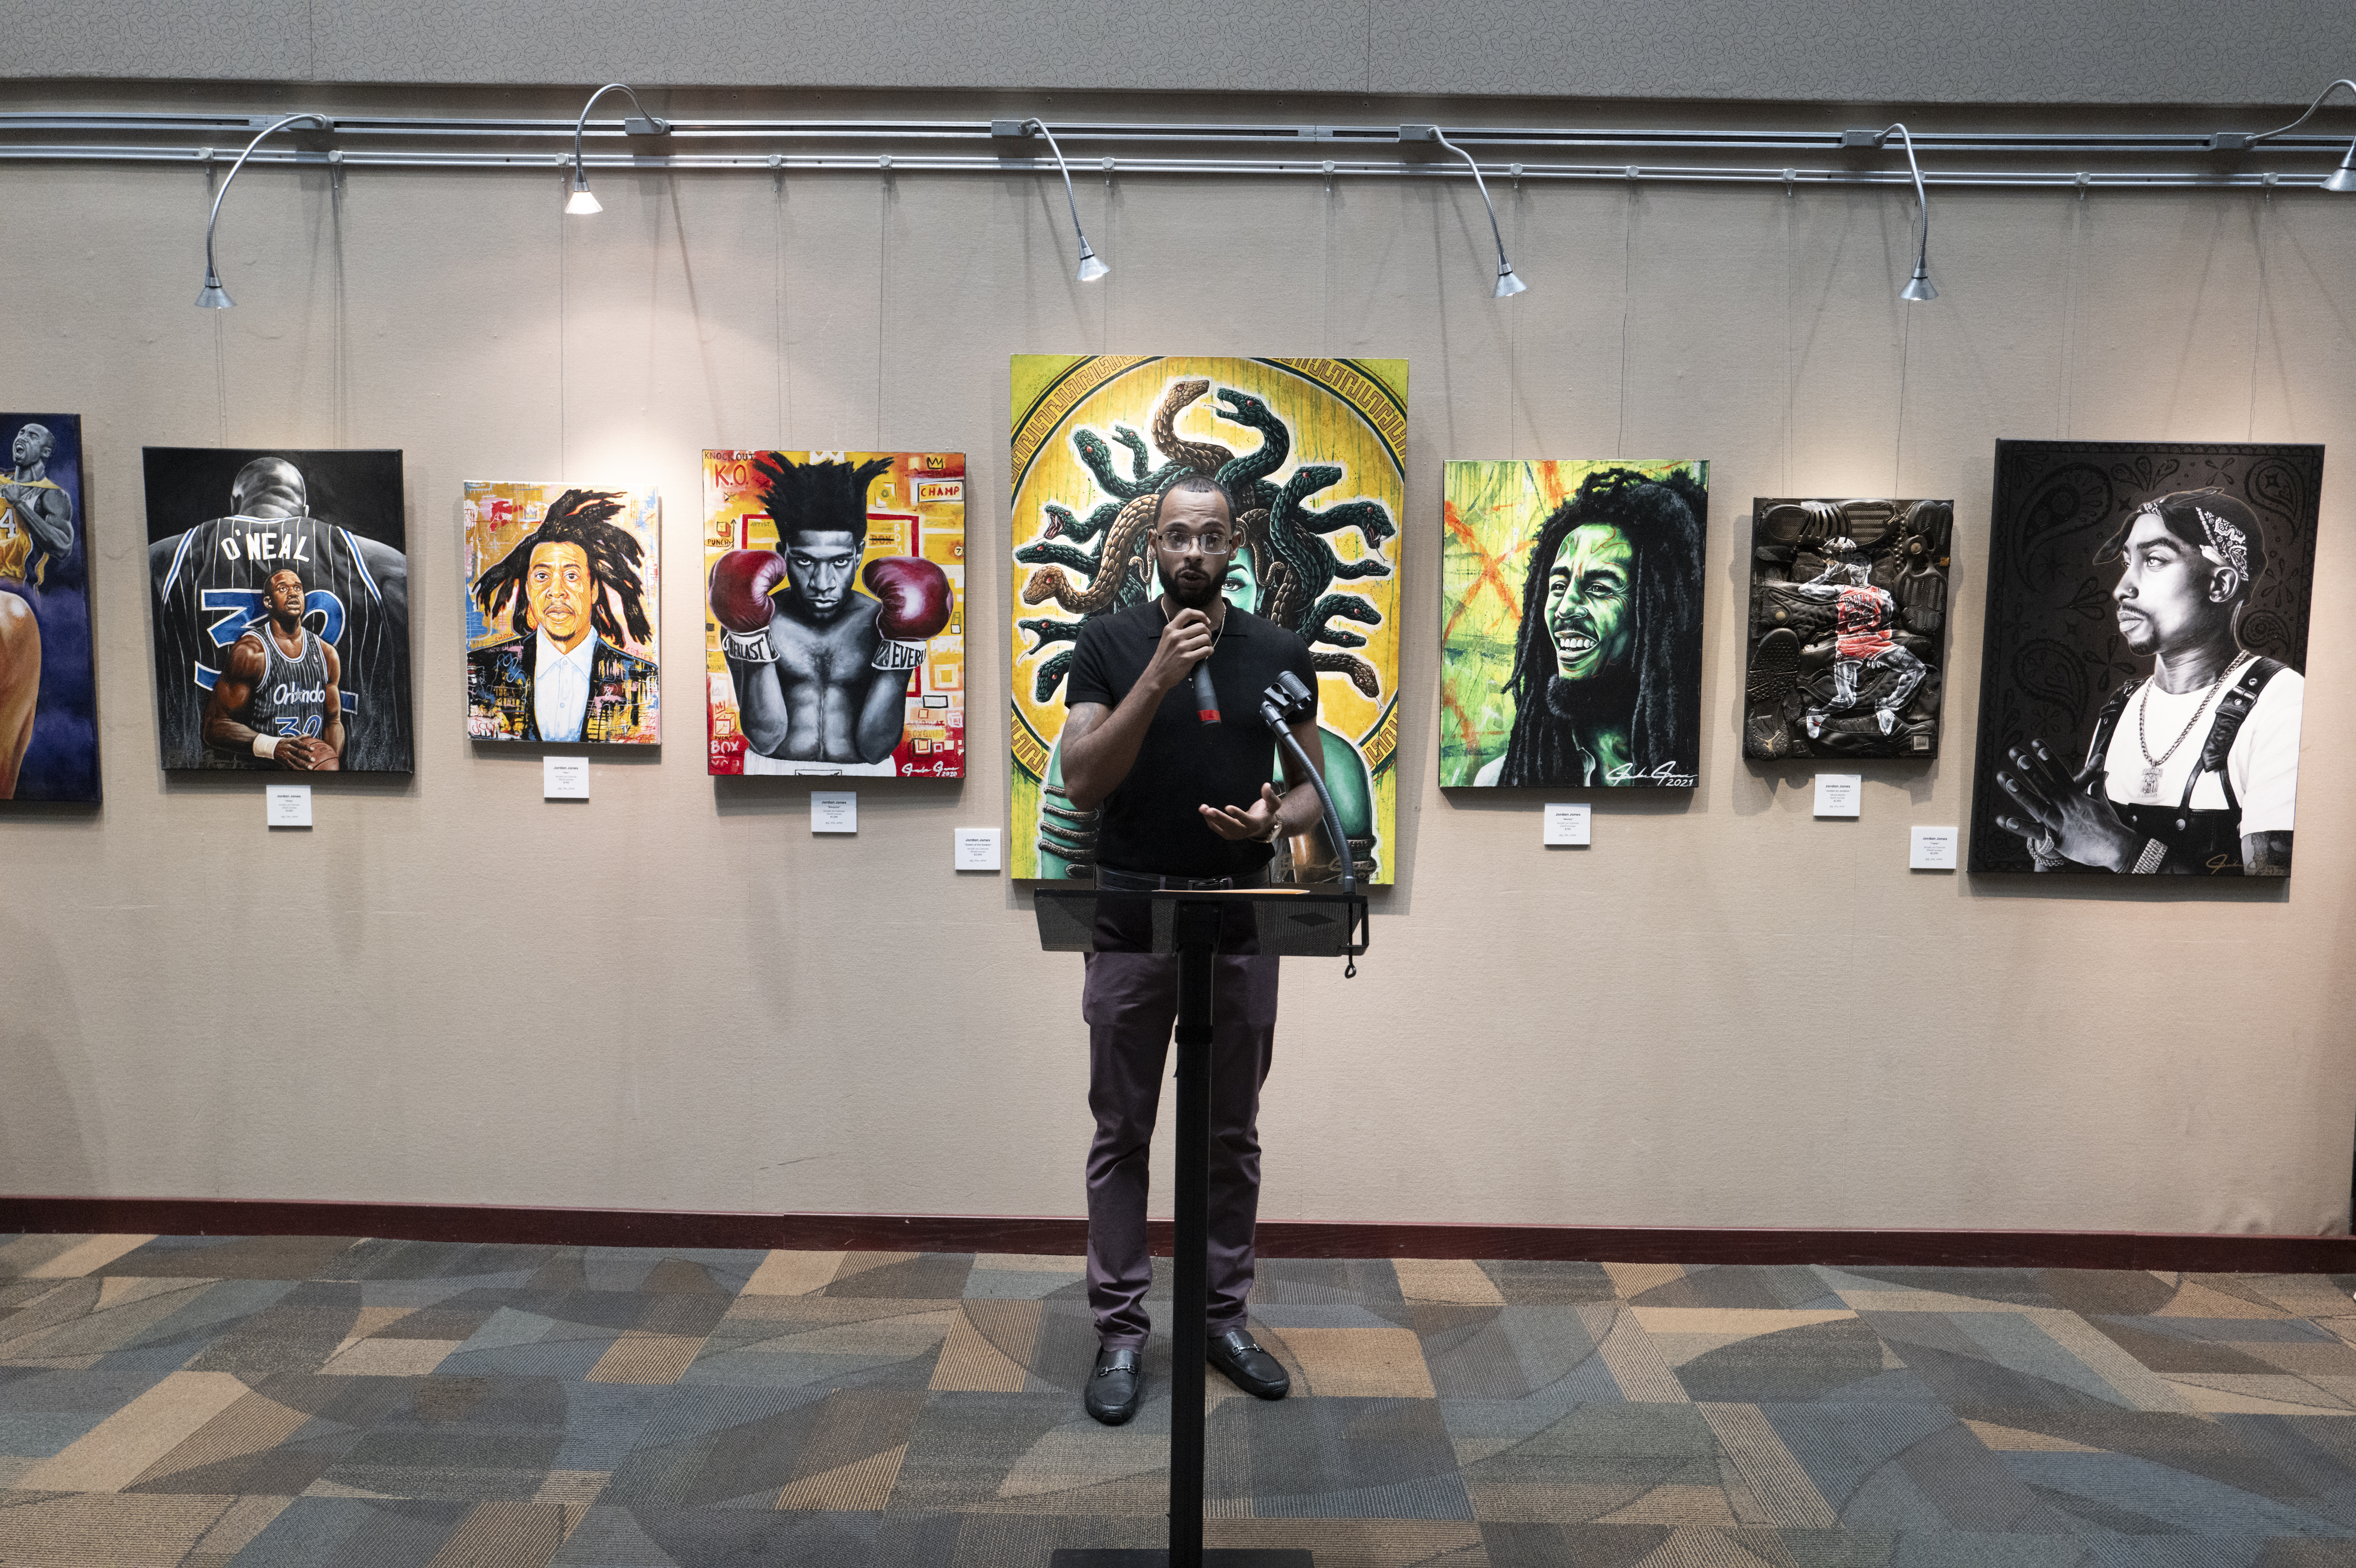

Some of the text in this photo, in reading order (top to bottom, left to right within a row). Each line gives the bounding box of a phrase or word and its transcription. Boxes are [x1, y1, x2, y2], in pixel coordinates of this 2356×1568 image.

[704, 451, 755, 461] KNOCK OUT
[715, 464, 749, 488] K.O.
[921, 486, 959, 497] CHAMP
[221, 529, 310, 563] O'NEAL
[711, 740, 740, 754] BOX
